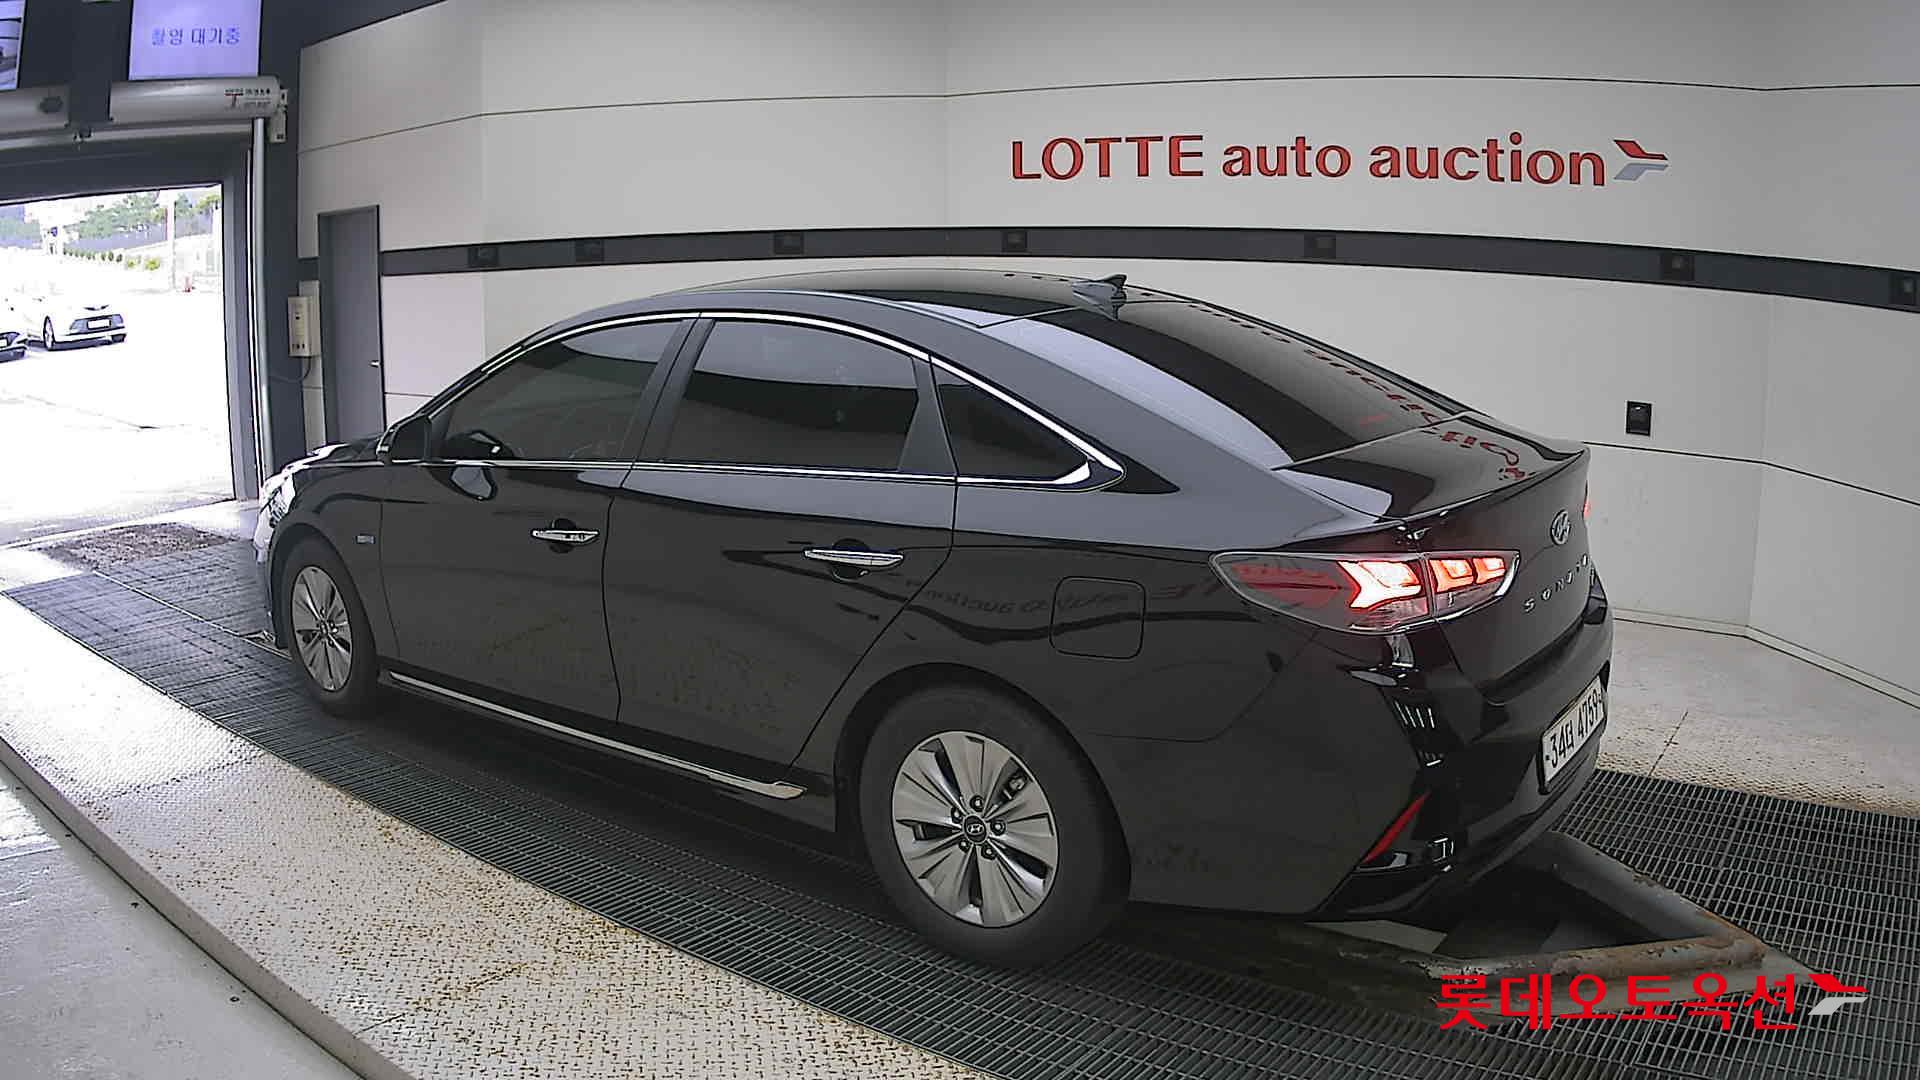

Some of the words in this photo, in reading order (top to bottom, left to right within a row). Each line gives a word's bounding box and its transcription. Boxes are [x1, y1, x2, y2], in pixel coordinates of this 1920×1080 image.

[191, 27, 240, 46] 대기중
[1011, 134, 1203, 180] LOTTE
[1222, 136, 1353, 178] auto
[1368, 132, 1606, 187] auction
[1577, 689, 1599, 738] 4759
